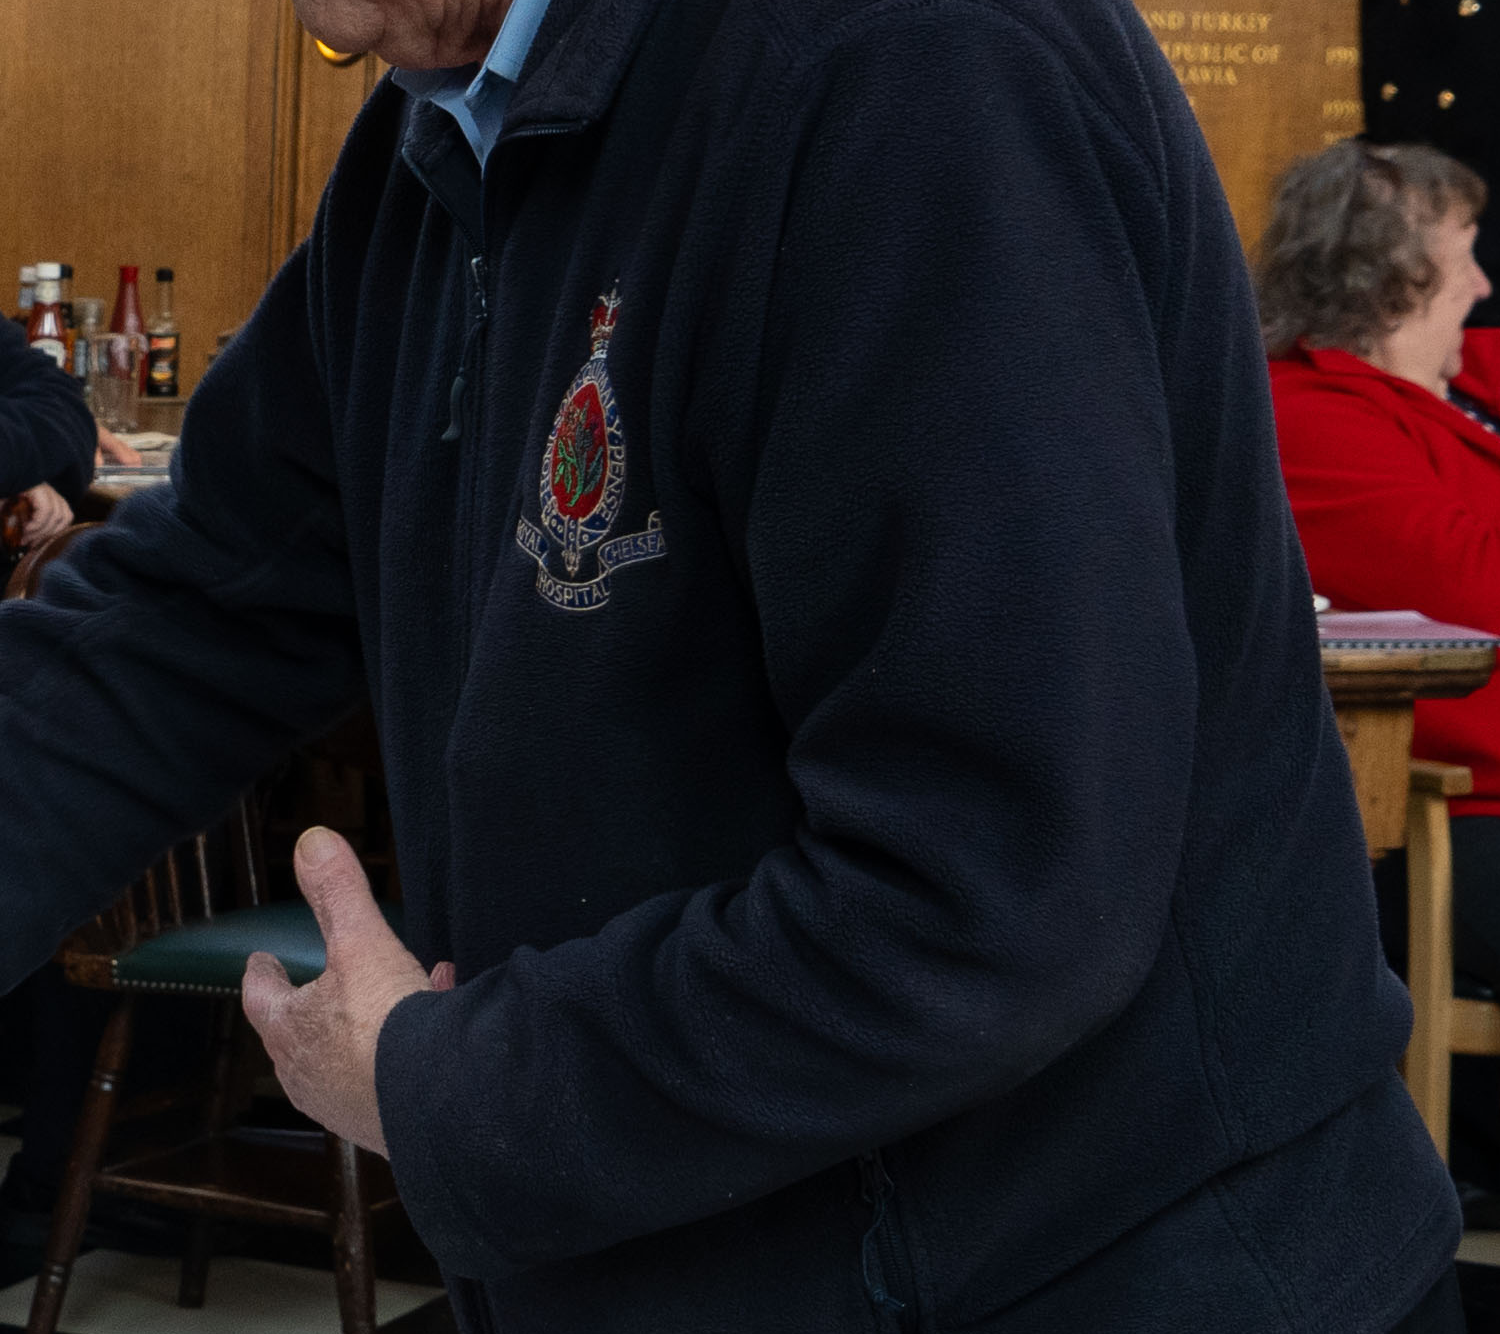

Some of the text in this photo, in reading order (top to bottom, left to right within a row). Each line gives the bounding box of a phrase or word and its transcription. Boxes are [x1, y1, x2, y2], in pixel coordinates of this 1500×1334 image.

[1192, 11, 1271, 32] TURKEY
[603, 531, 667, 565] CHELSEA
[537, 569, 611, 606] HOSPITAL
